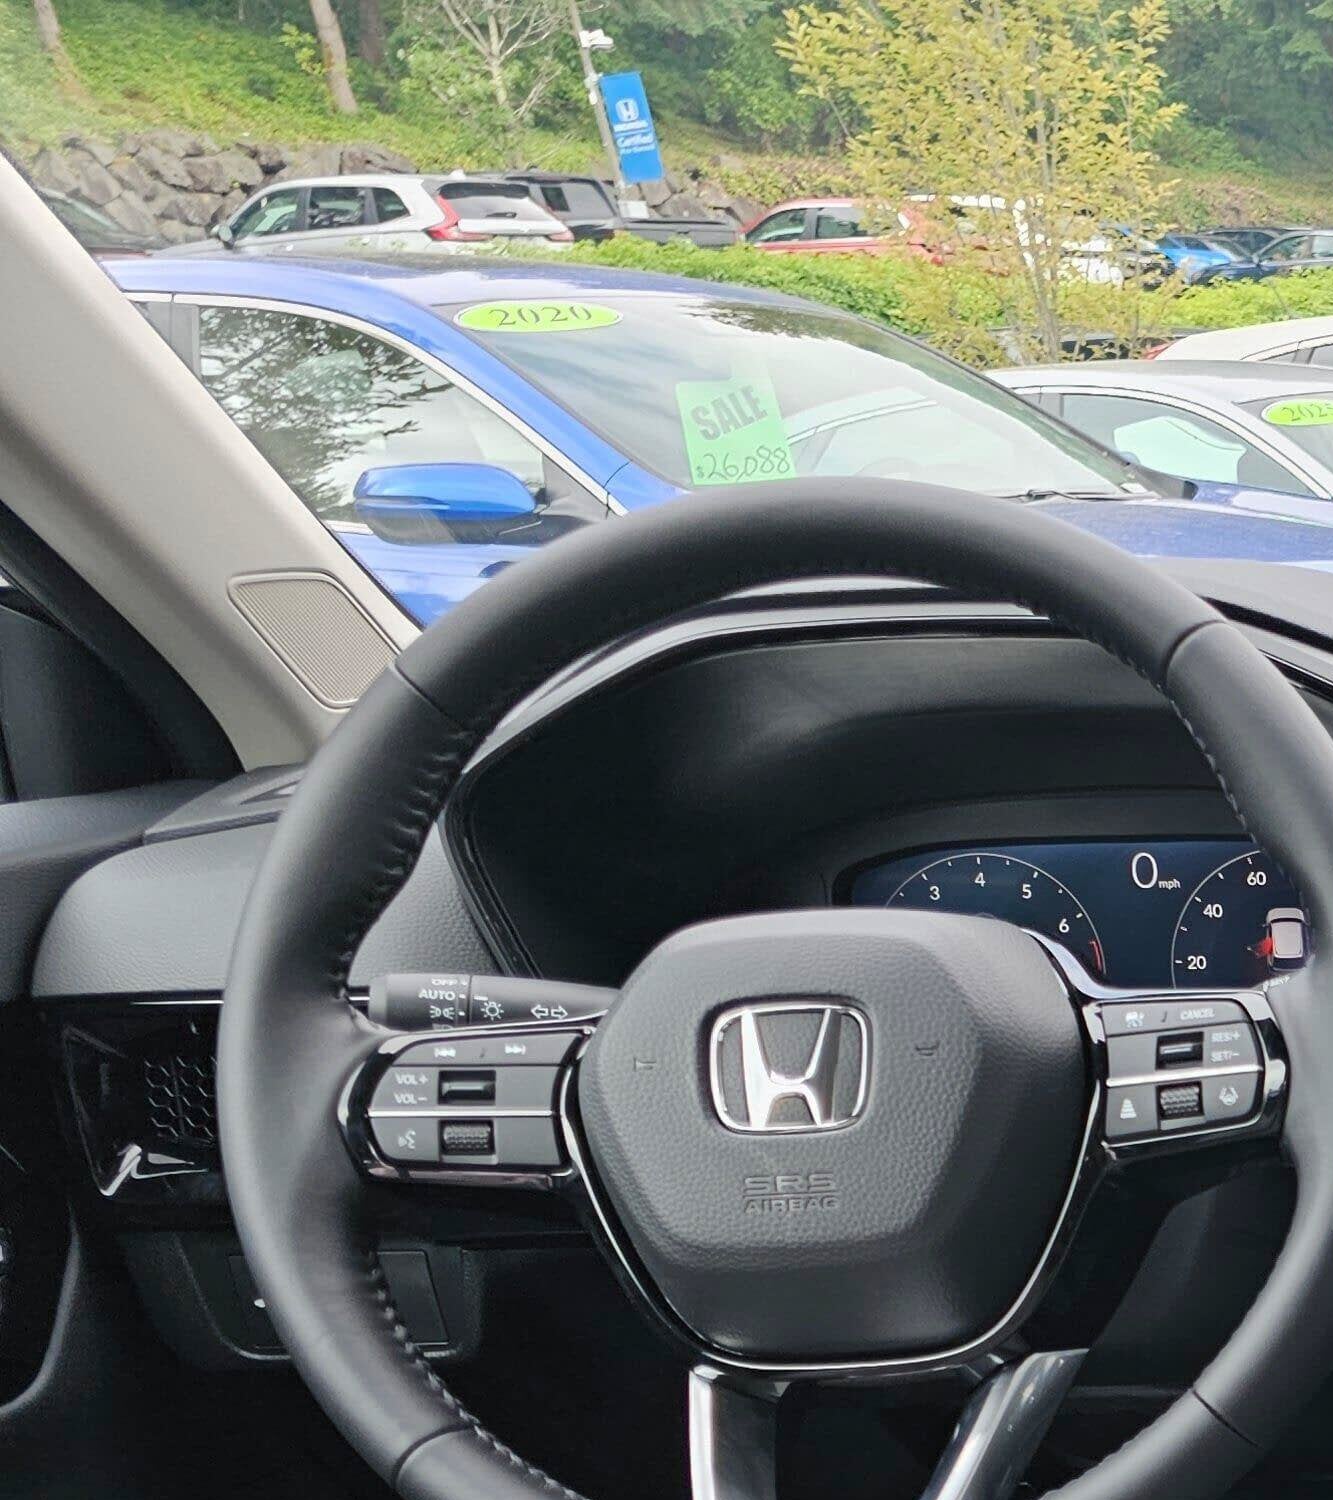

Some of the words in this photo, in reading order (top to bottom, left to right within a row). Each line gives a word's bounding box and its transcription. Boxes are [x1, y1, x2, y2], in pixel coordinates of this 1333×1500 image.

[488, 306, 592, 326] 2020
[690, 385, 768, 440] SALE
[1131, 852, 1159, 889] 0
[1158, 879, 1181, 890] mph
[1246, 871, 1267, 886] 60
[974, 872, 986, 888] 4
[929, 885, 941, 901] 3
[1022, 884, 1033, 900] 5
[1203, 903, 1223, 918] 40
[1058, 918, 1070, 933] 6
[1187, 955, 1207, 970] 20
[418, 989, 456, 1000] AUTO
[1180, 1008, 1217, 1021] CANCEL
[743, 1168, 837, 1193] SRS
[743, 1196, 840, 1215] AIRBAG
